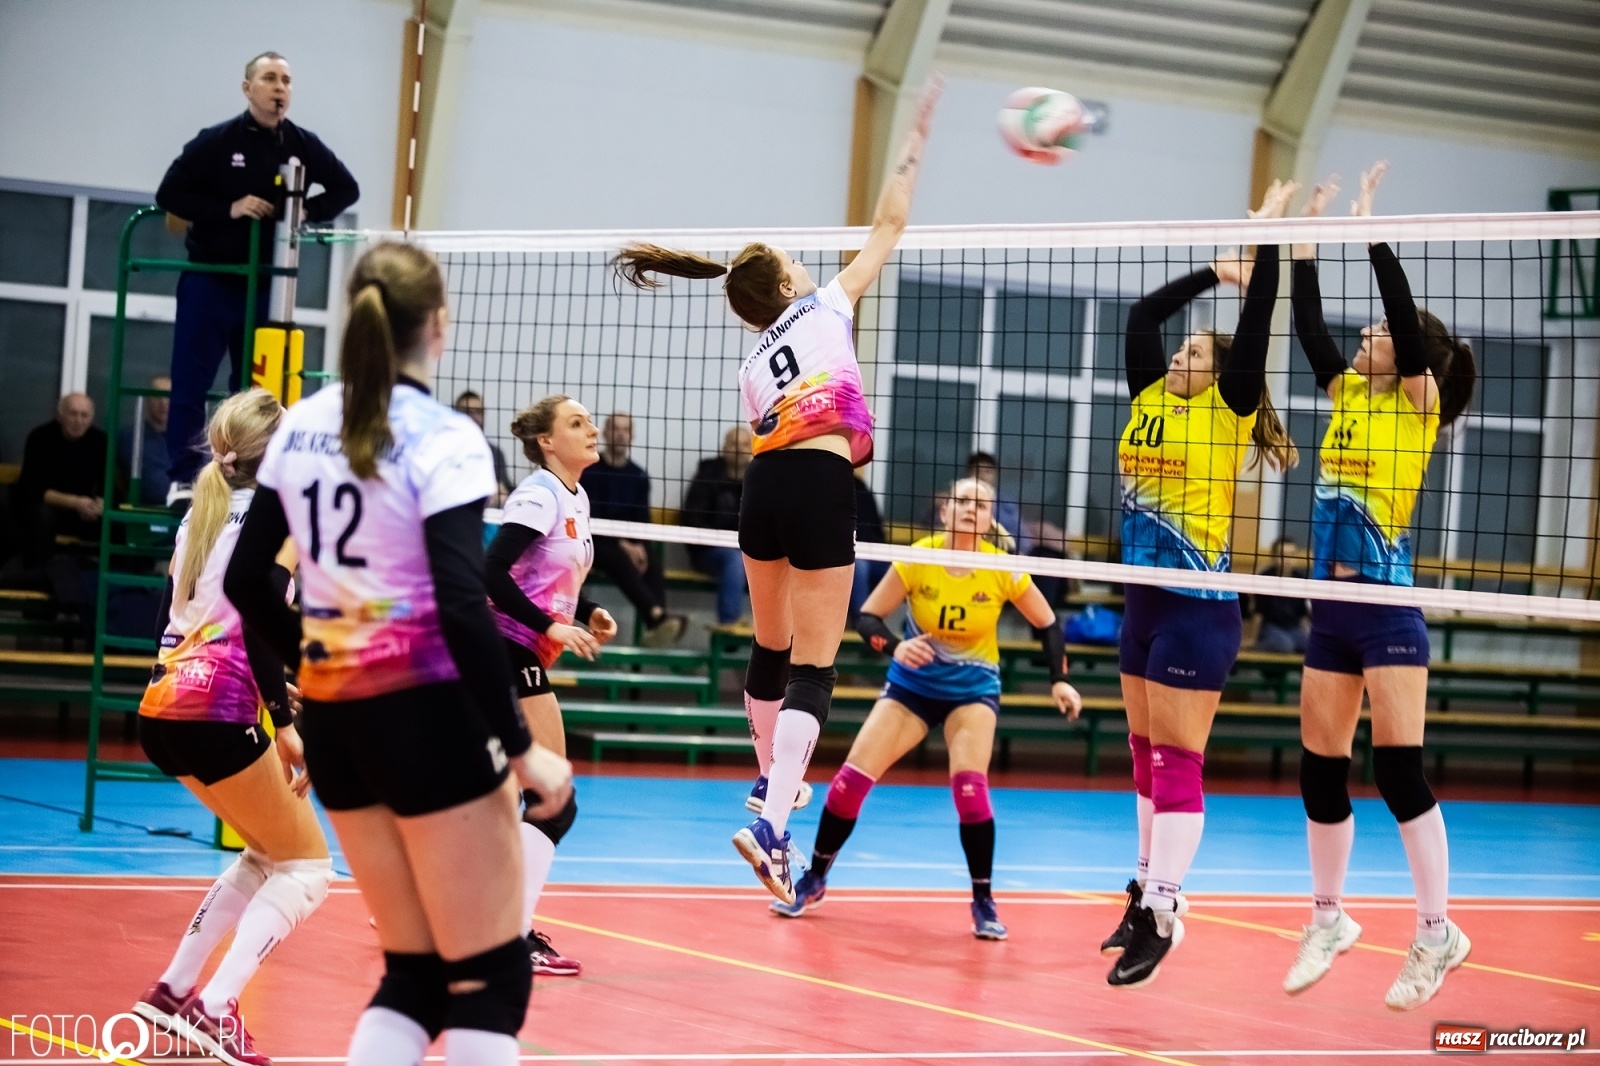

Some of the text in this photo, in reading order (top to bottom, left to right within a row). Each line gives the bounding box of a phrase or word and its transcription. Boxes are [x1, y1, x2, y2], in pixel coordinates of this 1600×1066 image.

[769, 345, 800, 390] 9
[1129, 413, 1164, 448] 20
[303, 479, 367, 568] 12
[938, 605, 966, 631] 12
[521, 666, 541, 687] 17
[1167, 666, 1196, 677] COLO
[245, 726, 258, 744] 7
